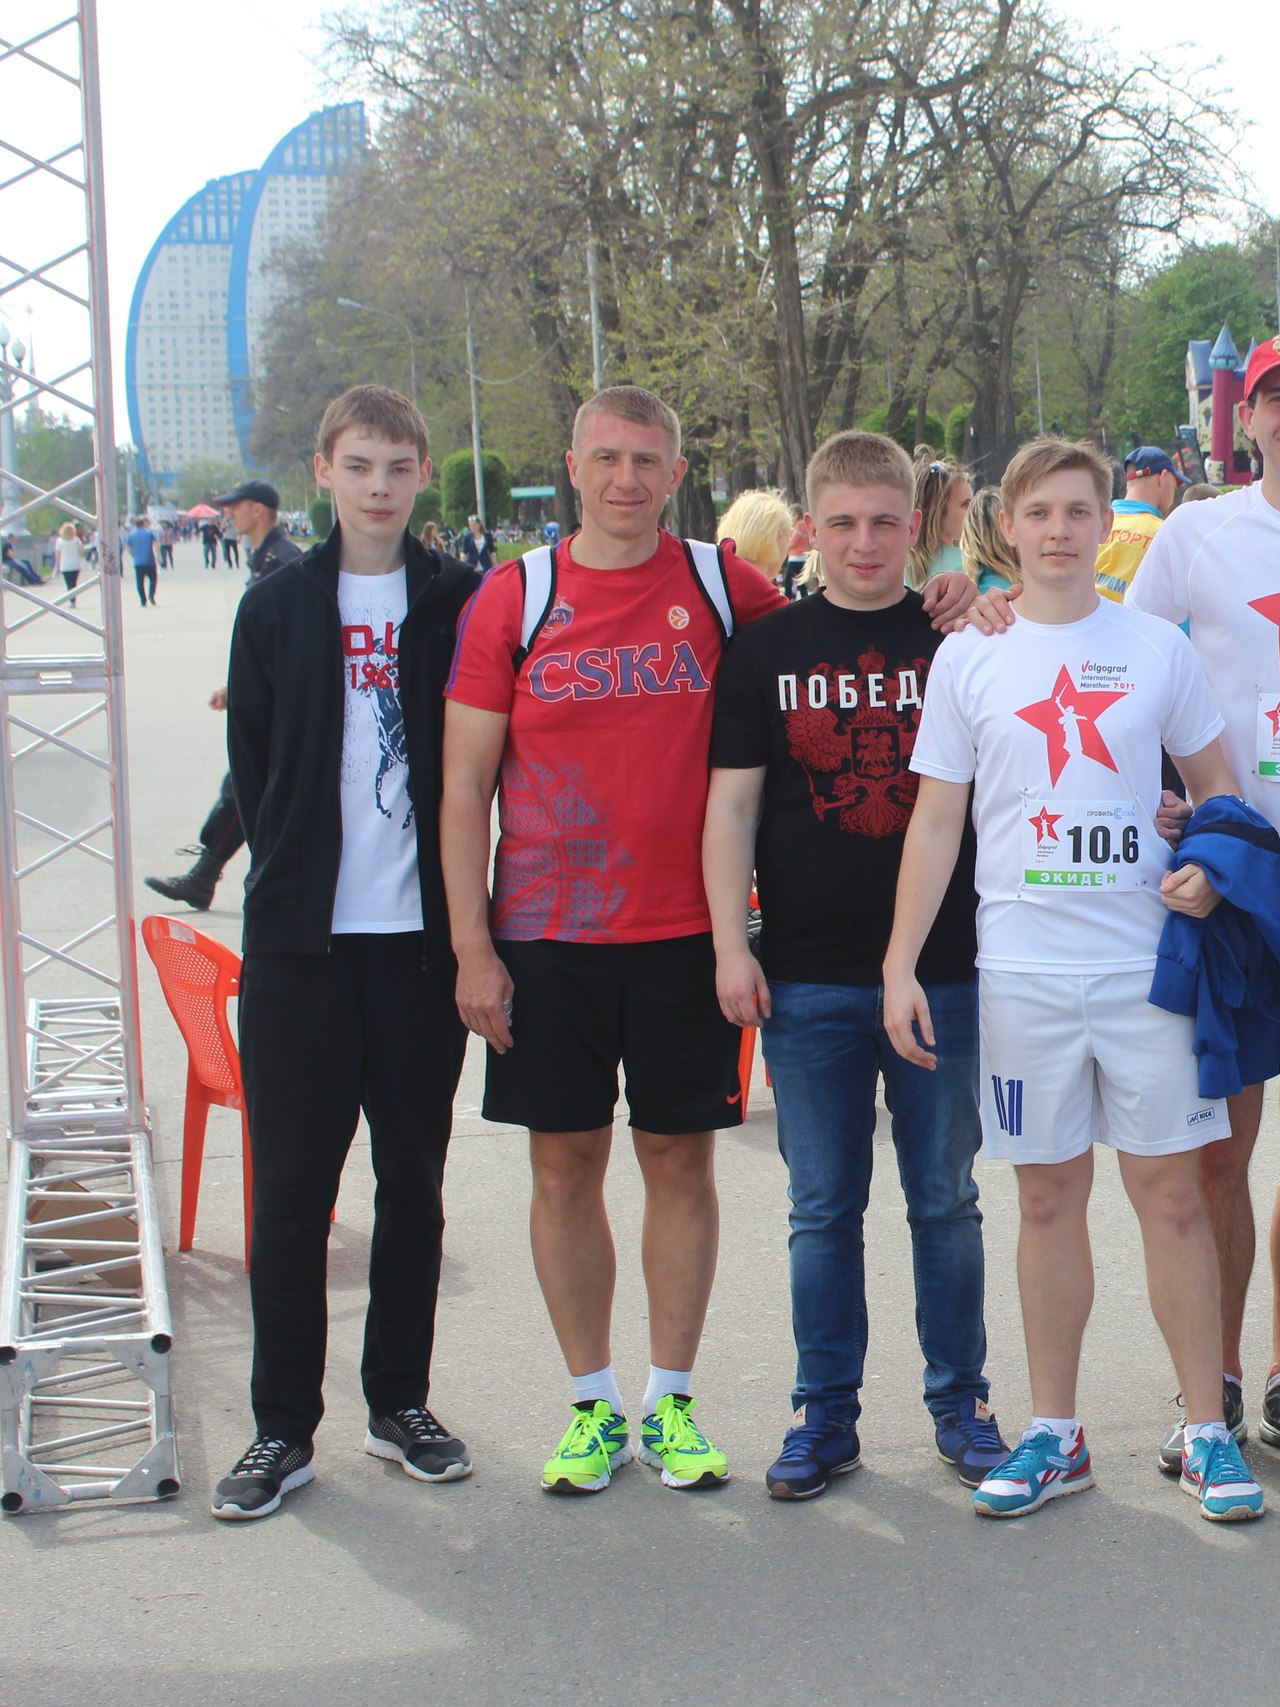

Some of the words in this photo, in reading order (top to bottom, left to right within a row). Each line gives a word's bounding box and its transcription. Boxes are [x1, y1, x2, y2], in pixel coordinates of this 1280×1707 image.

[527, 640, 712, 703] CSKA
[1081, 660, 1128, 674] Volgograd
[1081, 674, 1121, 682] International
[778, 669, 923, 712] ПОБЕД
[1113, 682, 1136, 690] 2015
[1066, 825, 1139, 864] 10.6
[1040, 872, 1117, 885] ЭКИДЕН
